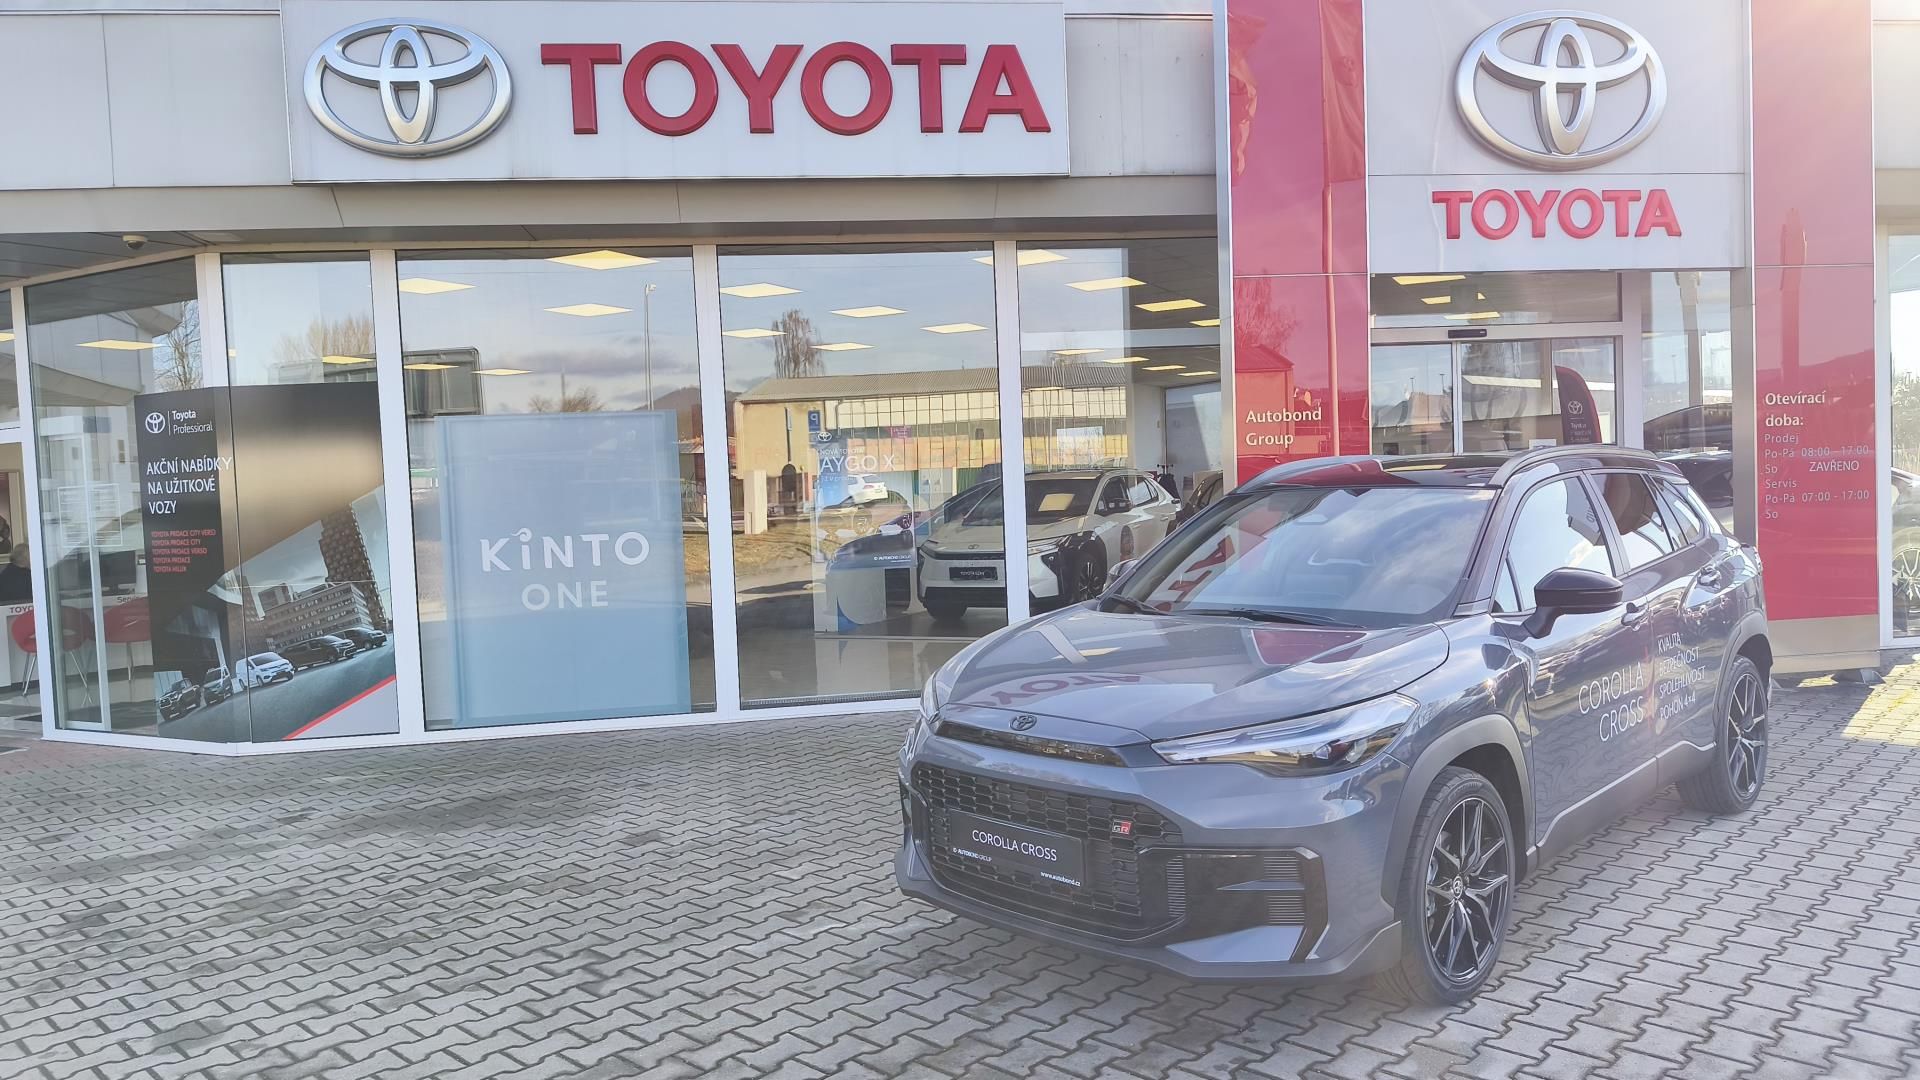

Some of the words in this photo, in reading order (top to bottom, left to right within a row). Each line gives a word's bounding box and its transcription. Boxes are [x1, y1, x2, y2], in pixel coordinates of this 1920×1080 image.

[541, 40, 1050, 136] TOYOTA
[1432, 188, 1682, 240] TOYOTA
[1765, 390, 1826, 405] Otevírací
[172, 410, 196, 421] Toyota
[1246, 408, 1321, 423] Autobond
[1765, 413, 1804, 427] doba:
[173, 420, 213, 434] Professional
[1246, 432, 1294, 449] Group
[1764, 433, 1799, 444] Prodej
[1764, 448, 1795, 459] Po-Pá
[1801, 447, 1830, 457] 08:00
[1841, 445, 1869, 456] 17:00
[146, 457, 179, 476] AKČNÍ
[181, 454, 232, 473] NABÍDKY
[820, 455, 878, 473] AYGO
[883, 454, 896, 471] X
[1765, 464, 1778, 474] So
[1809, 459, 1860, 472] ZAVŘENO
[148, 481, 164, 495] NA
[165, 474, 216, 494] UŽITKOVÉ
[1765, 478, 1798, 489] Servis
[1765, 493, 1795, 504] Po-Pá
[1801, 492, 1831, 502] 07:00
[1842, 489, 1870, 500] 17:00
[148, 500, 177, 515] VOZY
[1766, 510, 1778, 519] So
[521, 580, 609, 611] ONE
[1658, 632, 1682, 655] KVALITA
[1660, 646, 1700, 677] BEZPEČNOST
[1579, 662, 1644, 714] COROLLA
[1660, 665, 1706, 699] SPOLEHLIVOST
[1661, 696, 1684, 721] POHON
[1600, 696, 1644, 742] CROSS
[1112, 820, 1131, 835] GR
[972, 830, 1019, 852] COROLLA
[1021, 842, 1057, 862] CROSS
[1040, 871, 1081, 887] www.autobond.cz
